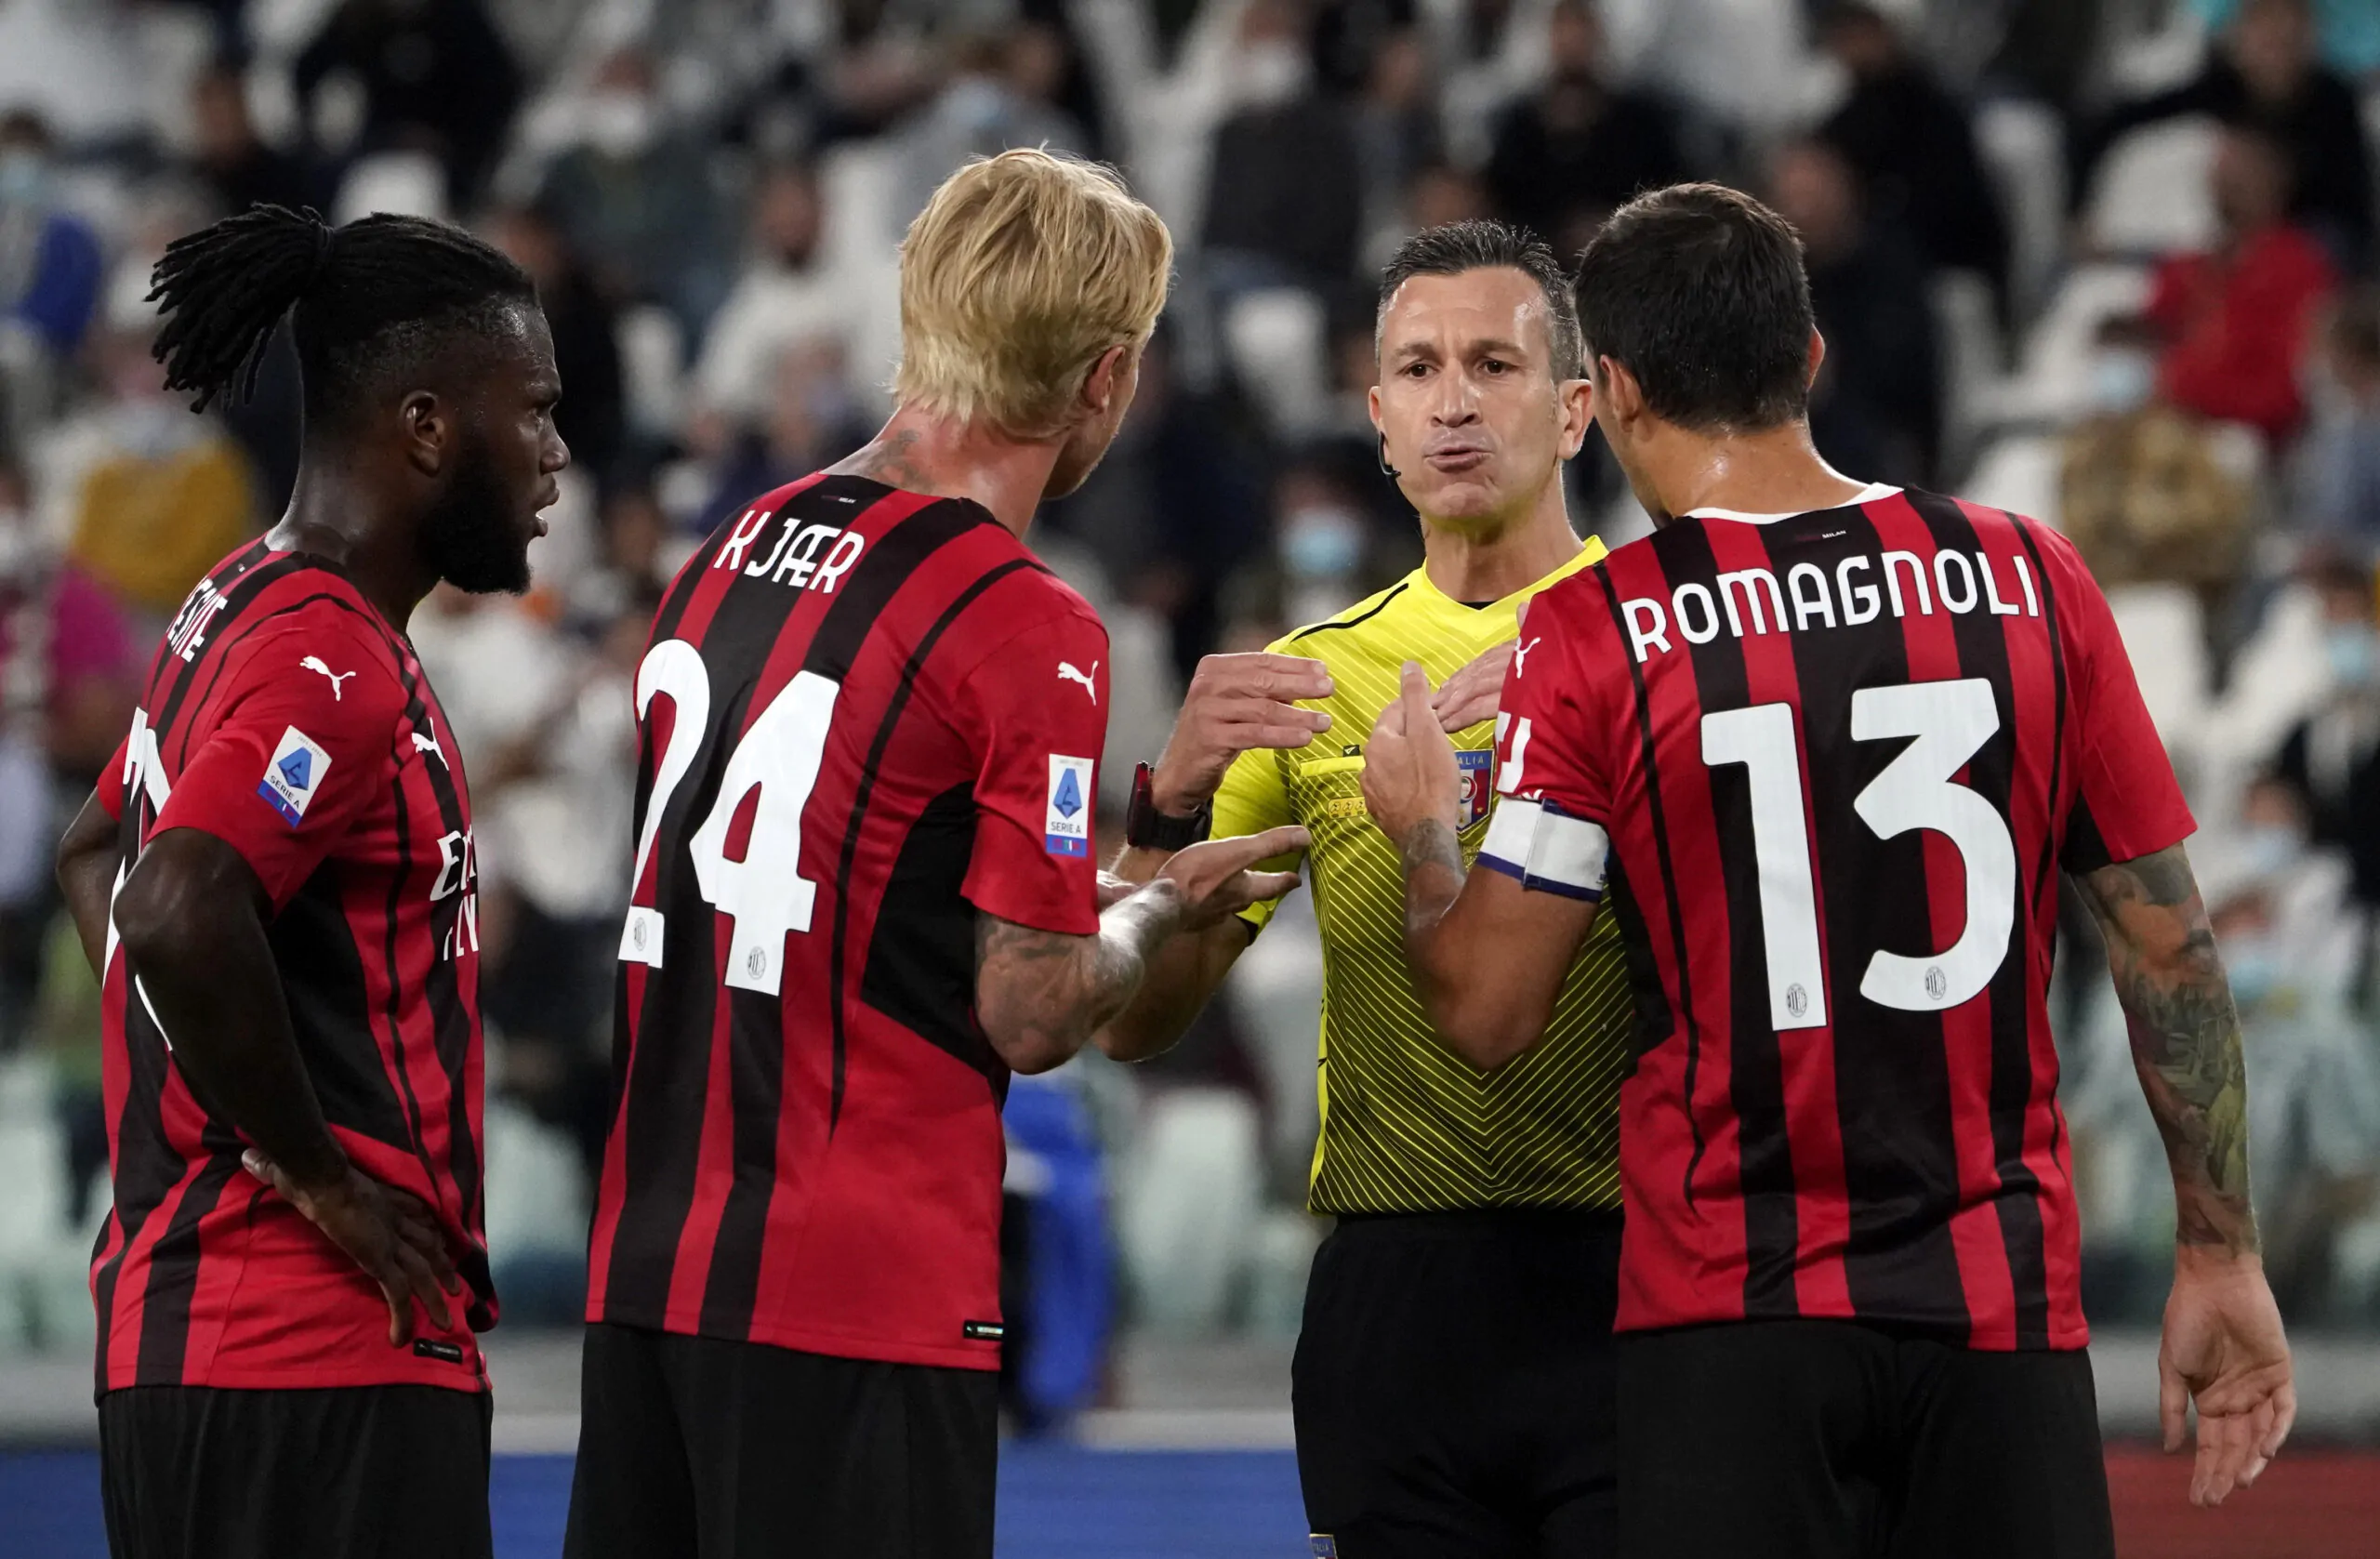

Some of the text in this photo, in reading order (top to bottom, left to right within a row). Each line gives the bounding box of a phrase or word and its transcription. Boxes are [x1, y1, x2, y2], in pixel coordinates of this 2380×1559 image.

[713, 509, 865, 594] KJÆR
[1620, 548, 2040, 663] ROMAGNOLI
[270, 775, 295, 801] SERIE
[1457, 755, 1485, 766] ALIA
[617, 639, 840, 997] 24
[1051, 821, 1073, 834] SERIE
[1700, 678, 2016, 1031] 13
